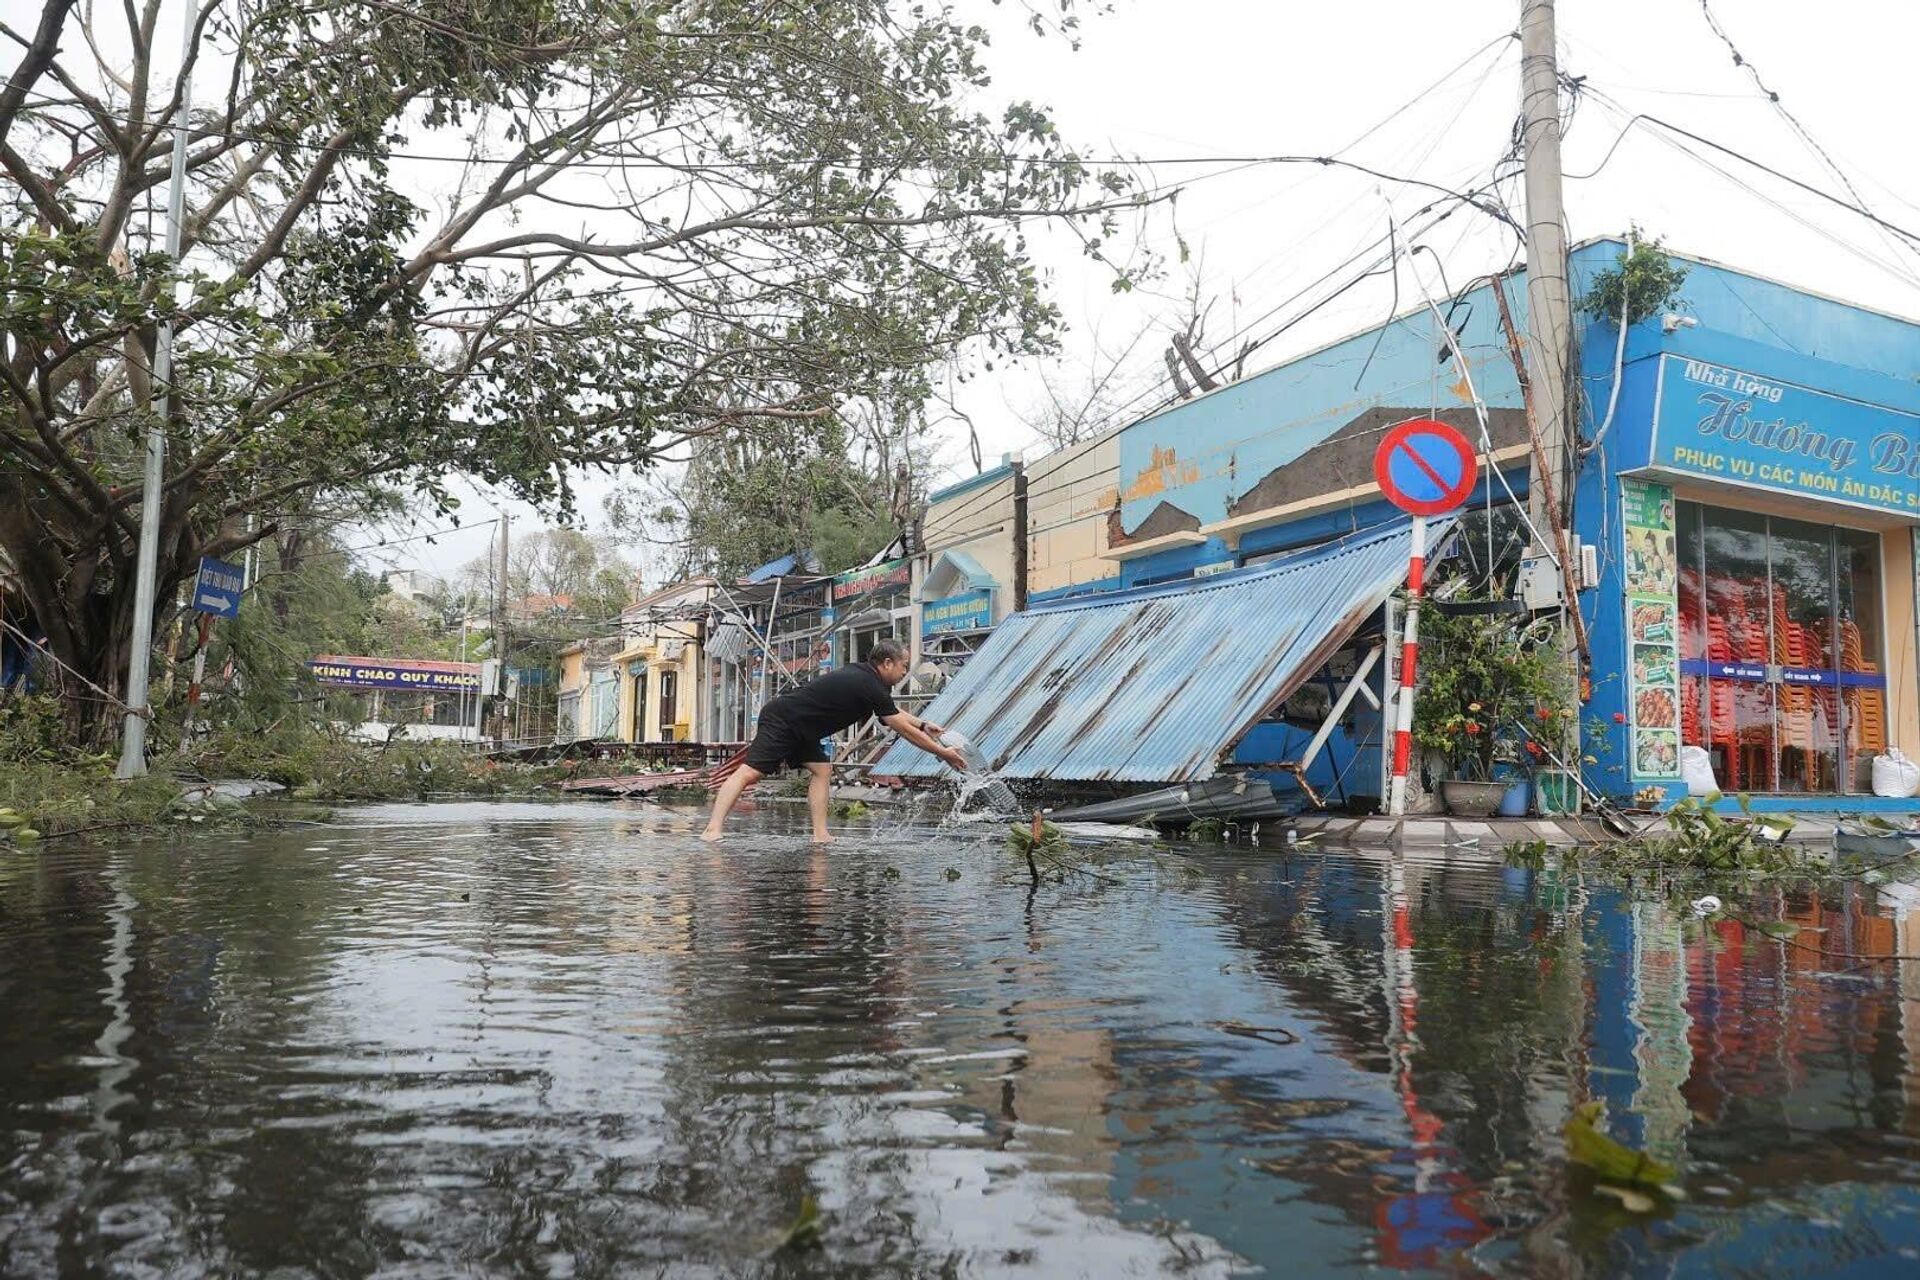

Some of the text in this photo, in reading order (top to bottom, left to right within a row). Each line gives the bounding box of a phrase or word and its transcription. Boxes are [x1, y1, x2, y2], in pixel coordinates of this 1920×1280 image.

[1697, 392, 1857, 471] Hương
[1674, 447, 1724, 472] PHỤC
[1730, 458, 1755, 480] VỤ
[1760, 463, 1795, 484] CÁC
[1799, 472, 1838, 492] MÓN
[1842, 476, 1865, 497] ĂN
[1869, 484, 1902, 506] ĐẶC
[312, 665, 351, 678] KÍNH
